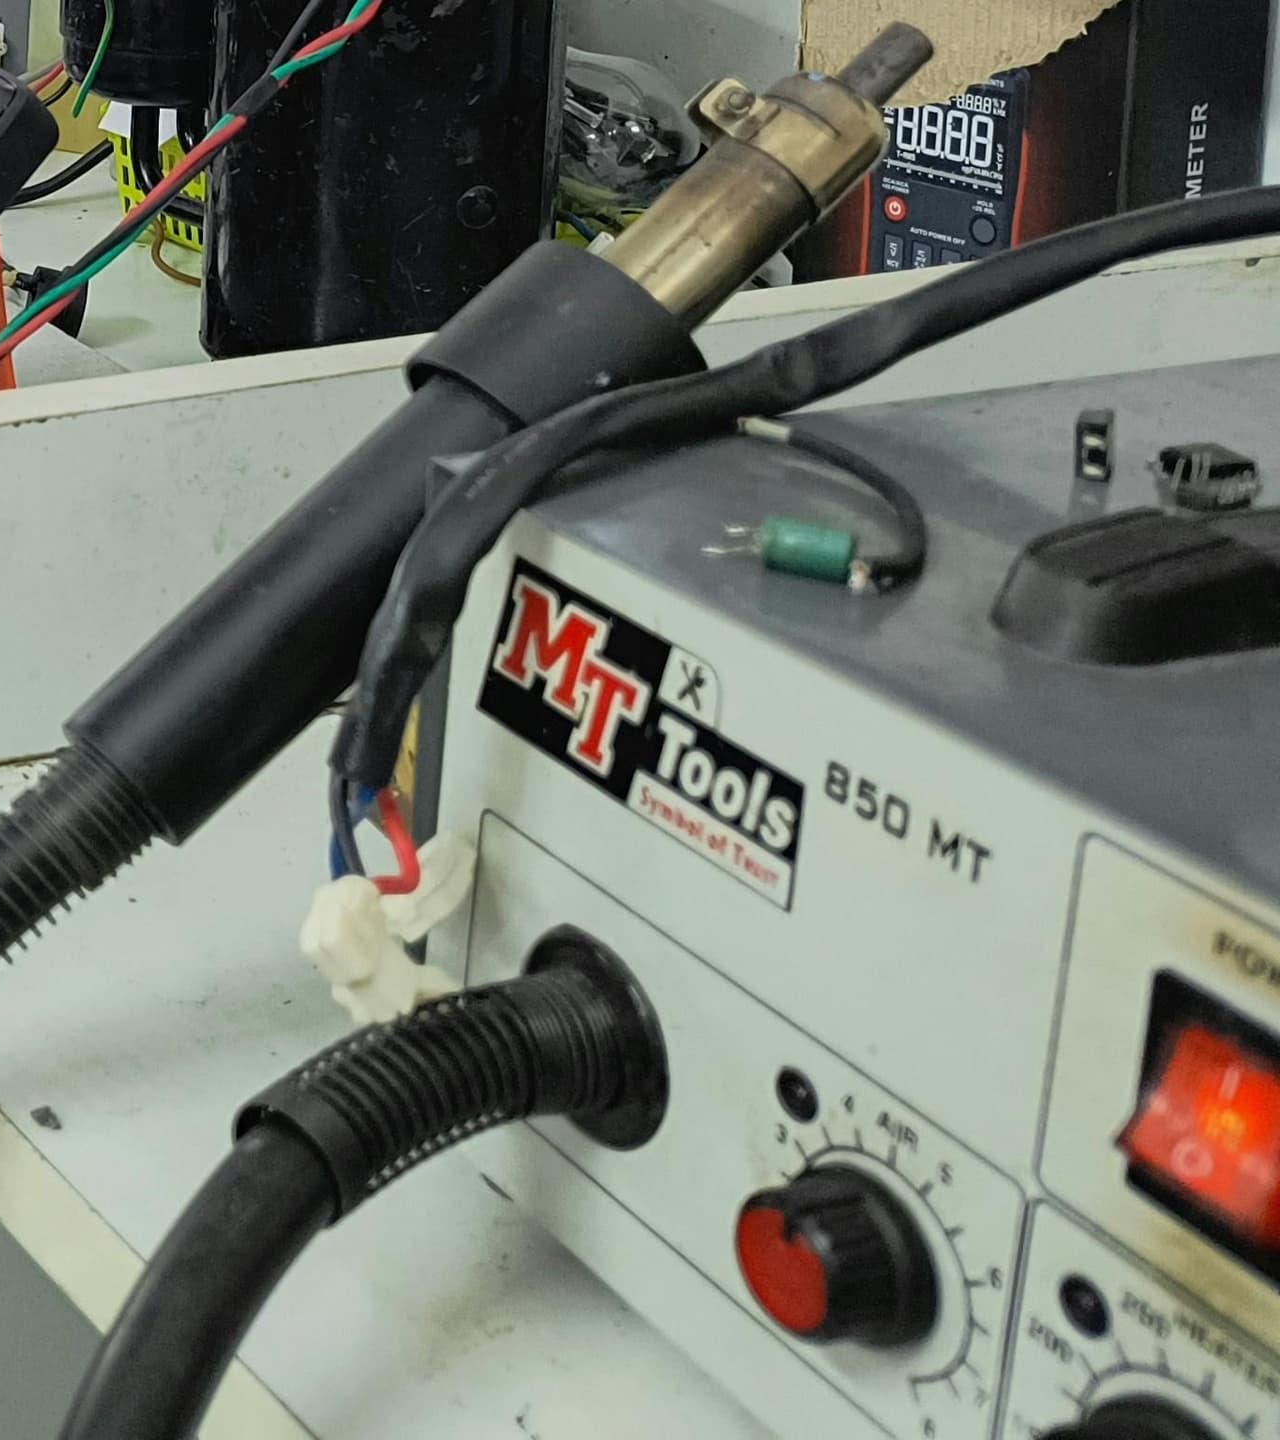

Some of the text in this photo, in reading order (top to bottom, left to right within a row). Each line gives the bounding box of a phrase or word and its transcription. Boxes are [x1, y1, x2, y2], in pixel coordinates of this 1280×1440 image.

[1184, 102, 1209, 200] METER
[495, 573, 654, 778] MT
[655, 711, 800, 854] Tools
[823, 759, 993, 884] 850 MT
